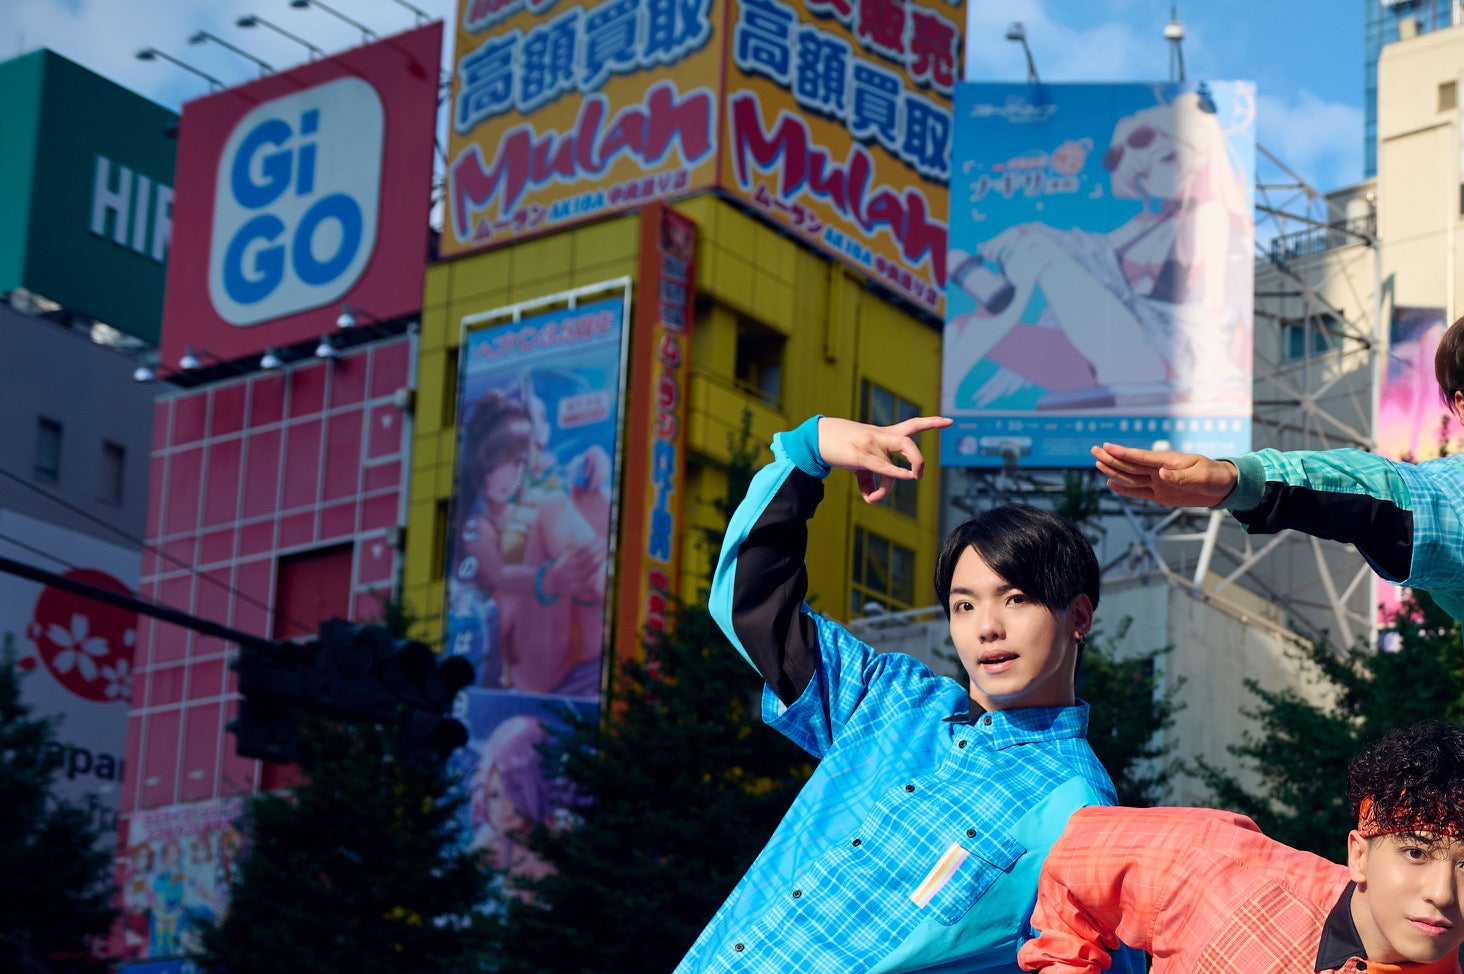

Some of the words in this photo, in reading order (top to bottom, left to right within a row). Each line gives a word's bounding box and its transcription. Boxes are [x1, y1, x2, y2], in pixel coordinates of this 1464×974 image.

[452, 82, 713, 239] Mulan
[737, 0, 950, 174] 高額買取
[731, 93, 948, 291] Mulan
